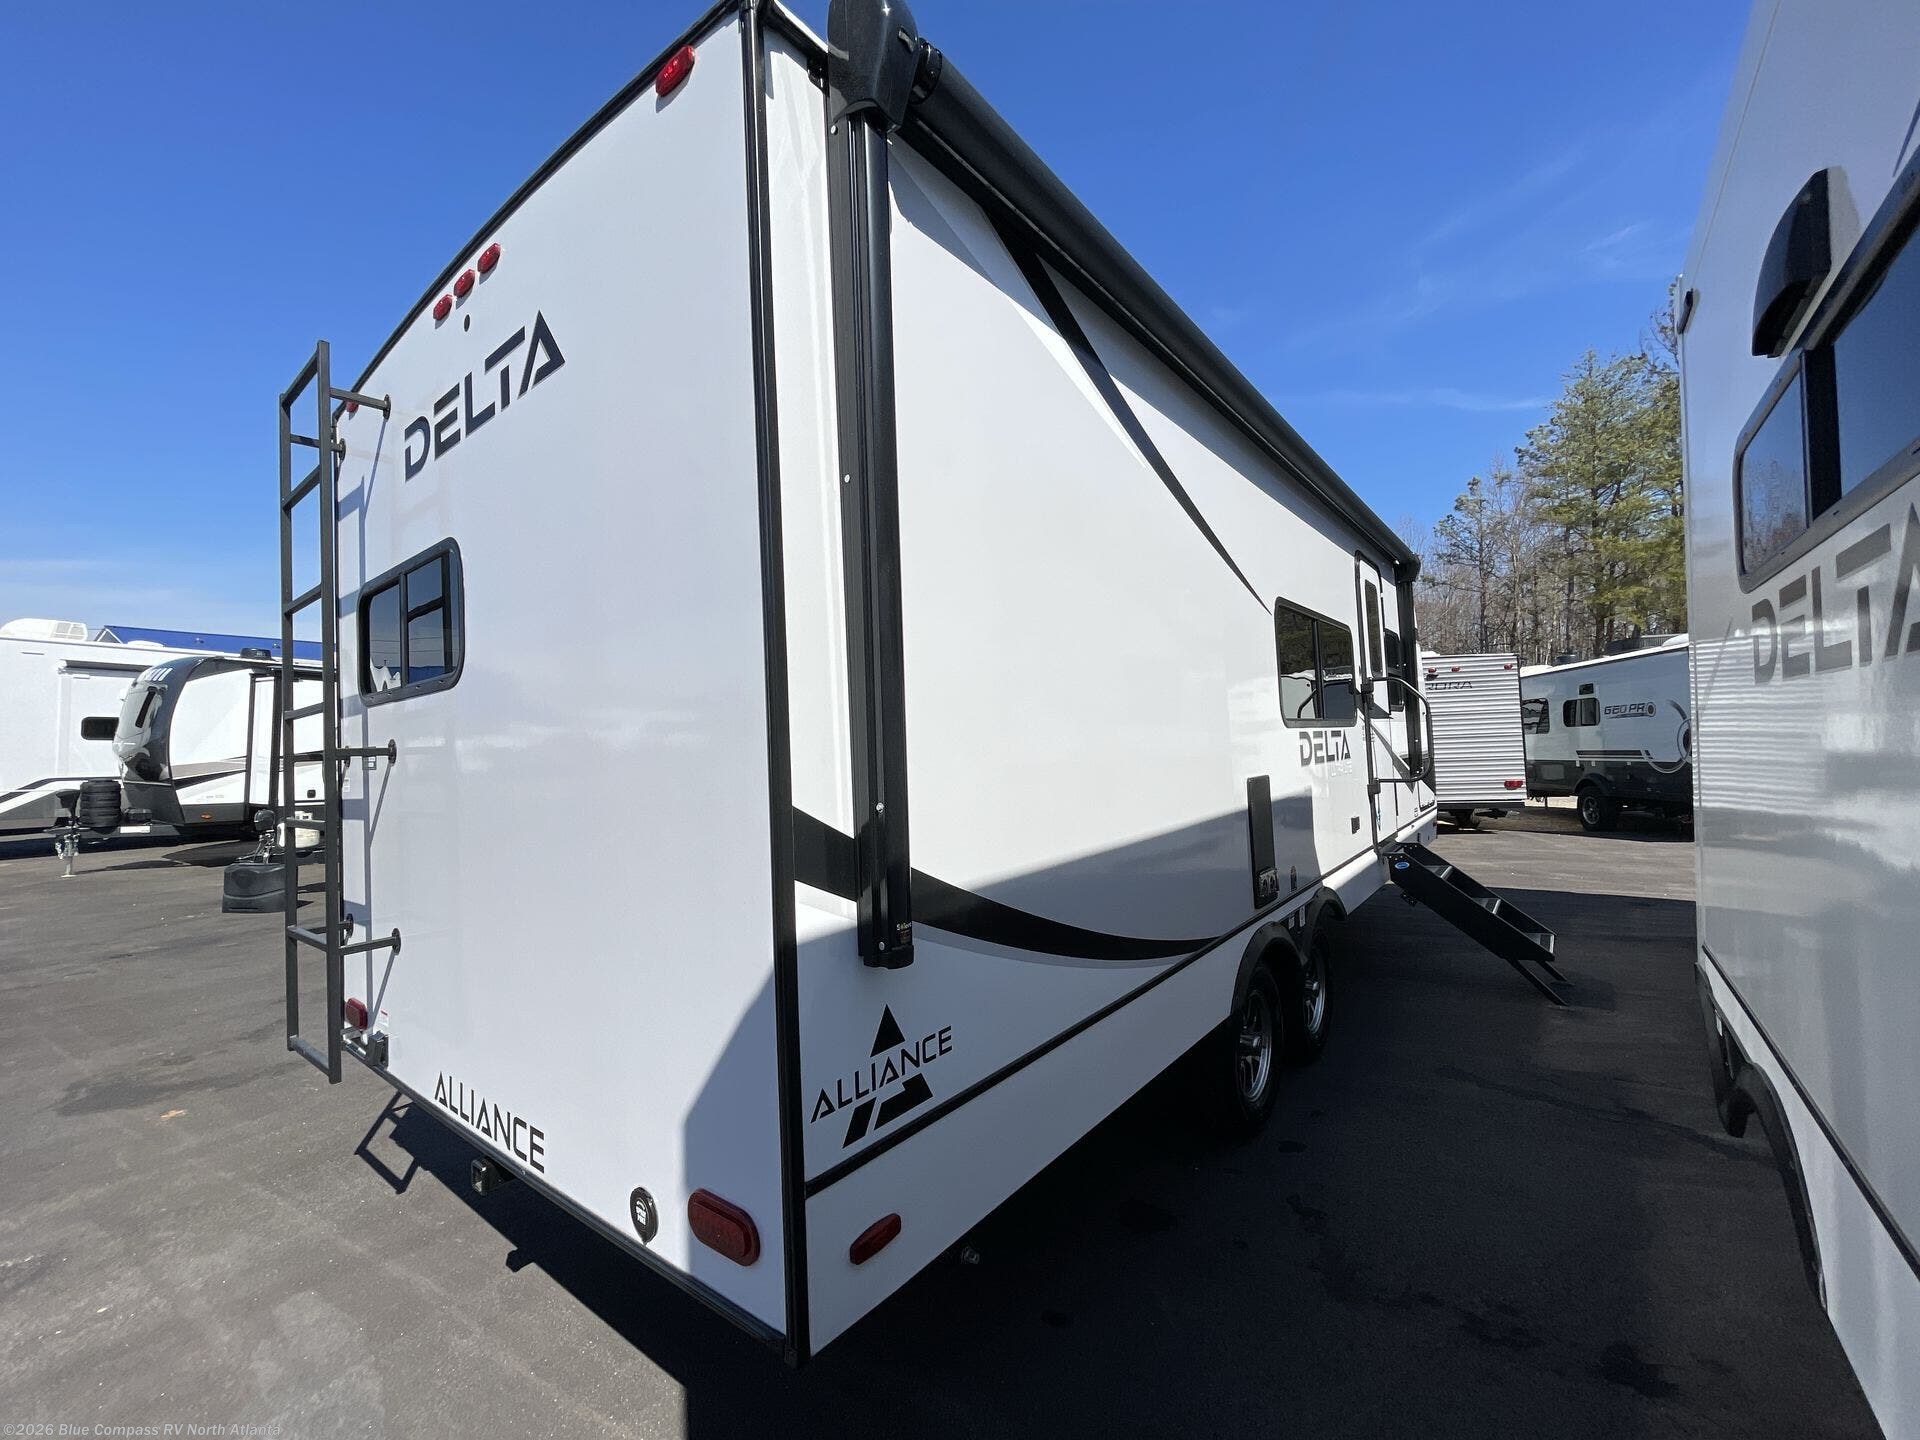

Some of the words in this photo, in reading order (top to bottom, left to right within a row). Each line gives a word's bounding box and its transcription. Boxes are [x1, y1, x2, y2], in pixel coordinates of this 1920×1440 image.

[405, 310, 565, 482] DELTA
[1299, 729, 1351, 767] DELTA
[434, 1070, 544, 1174] ALLIANCE
[811, 1026, 952, 1123] ALLIANCE
